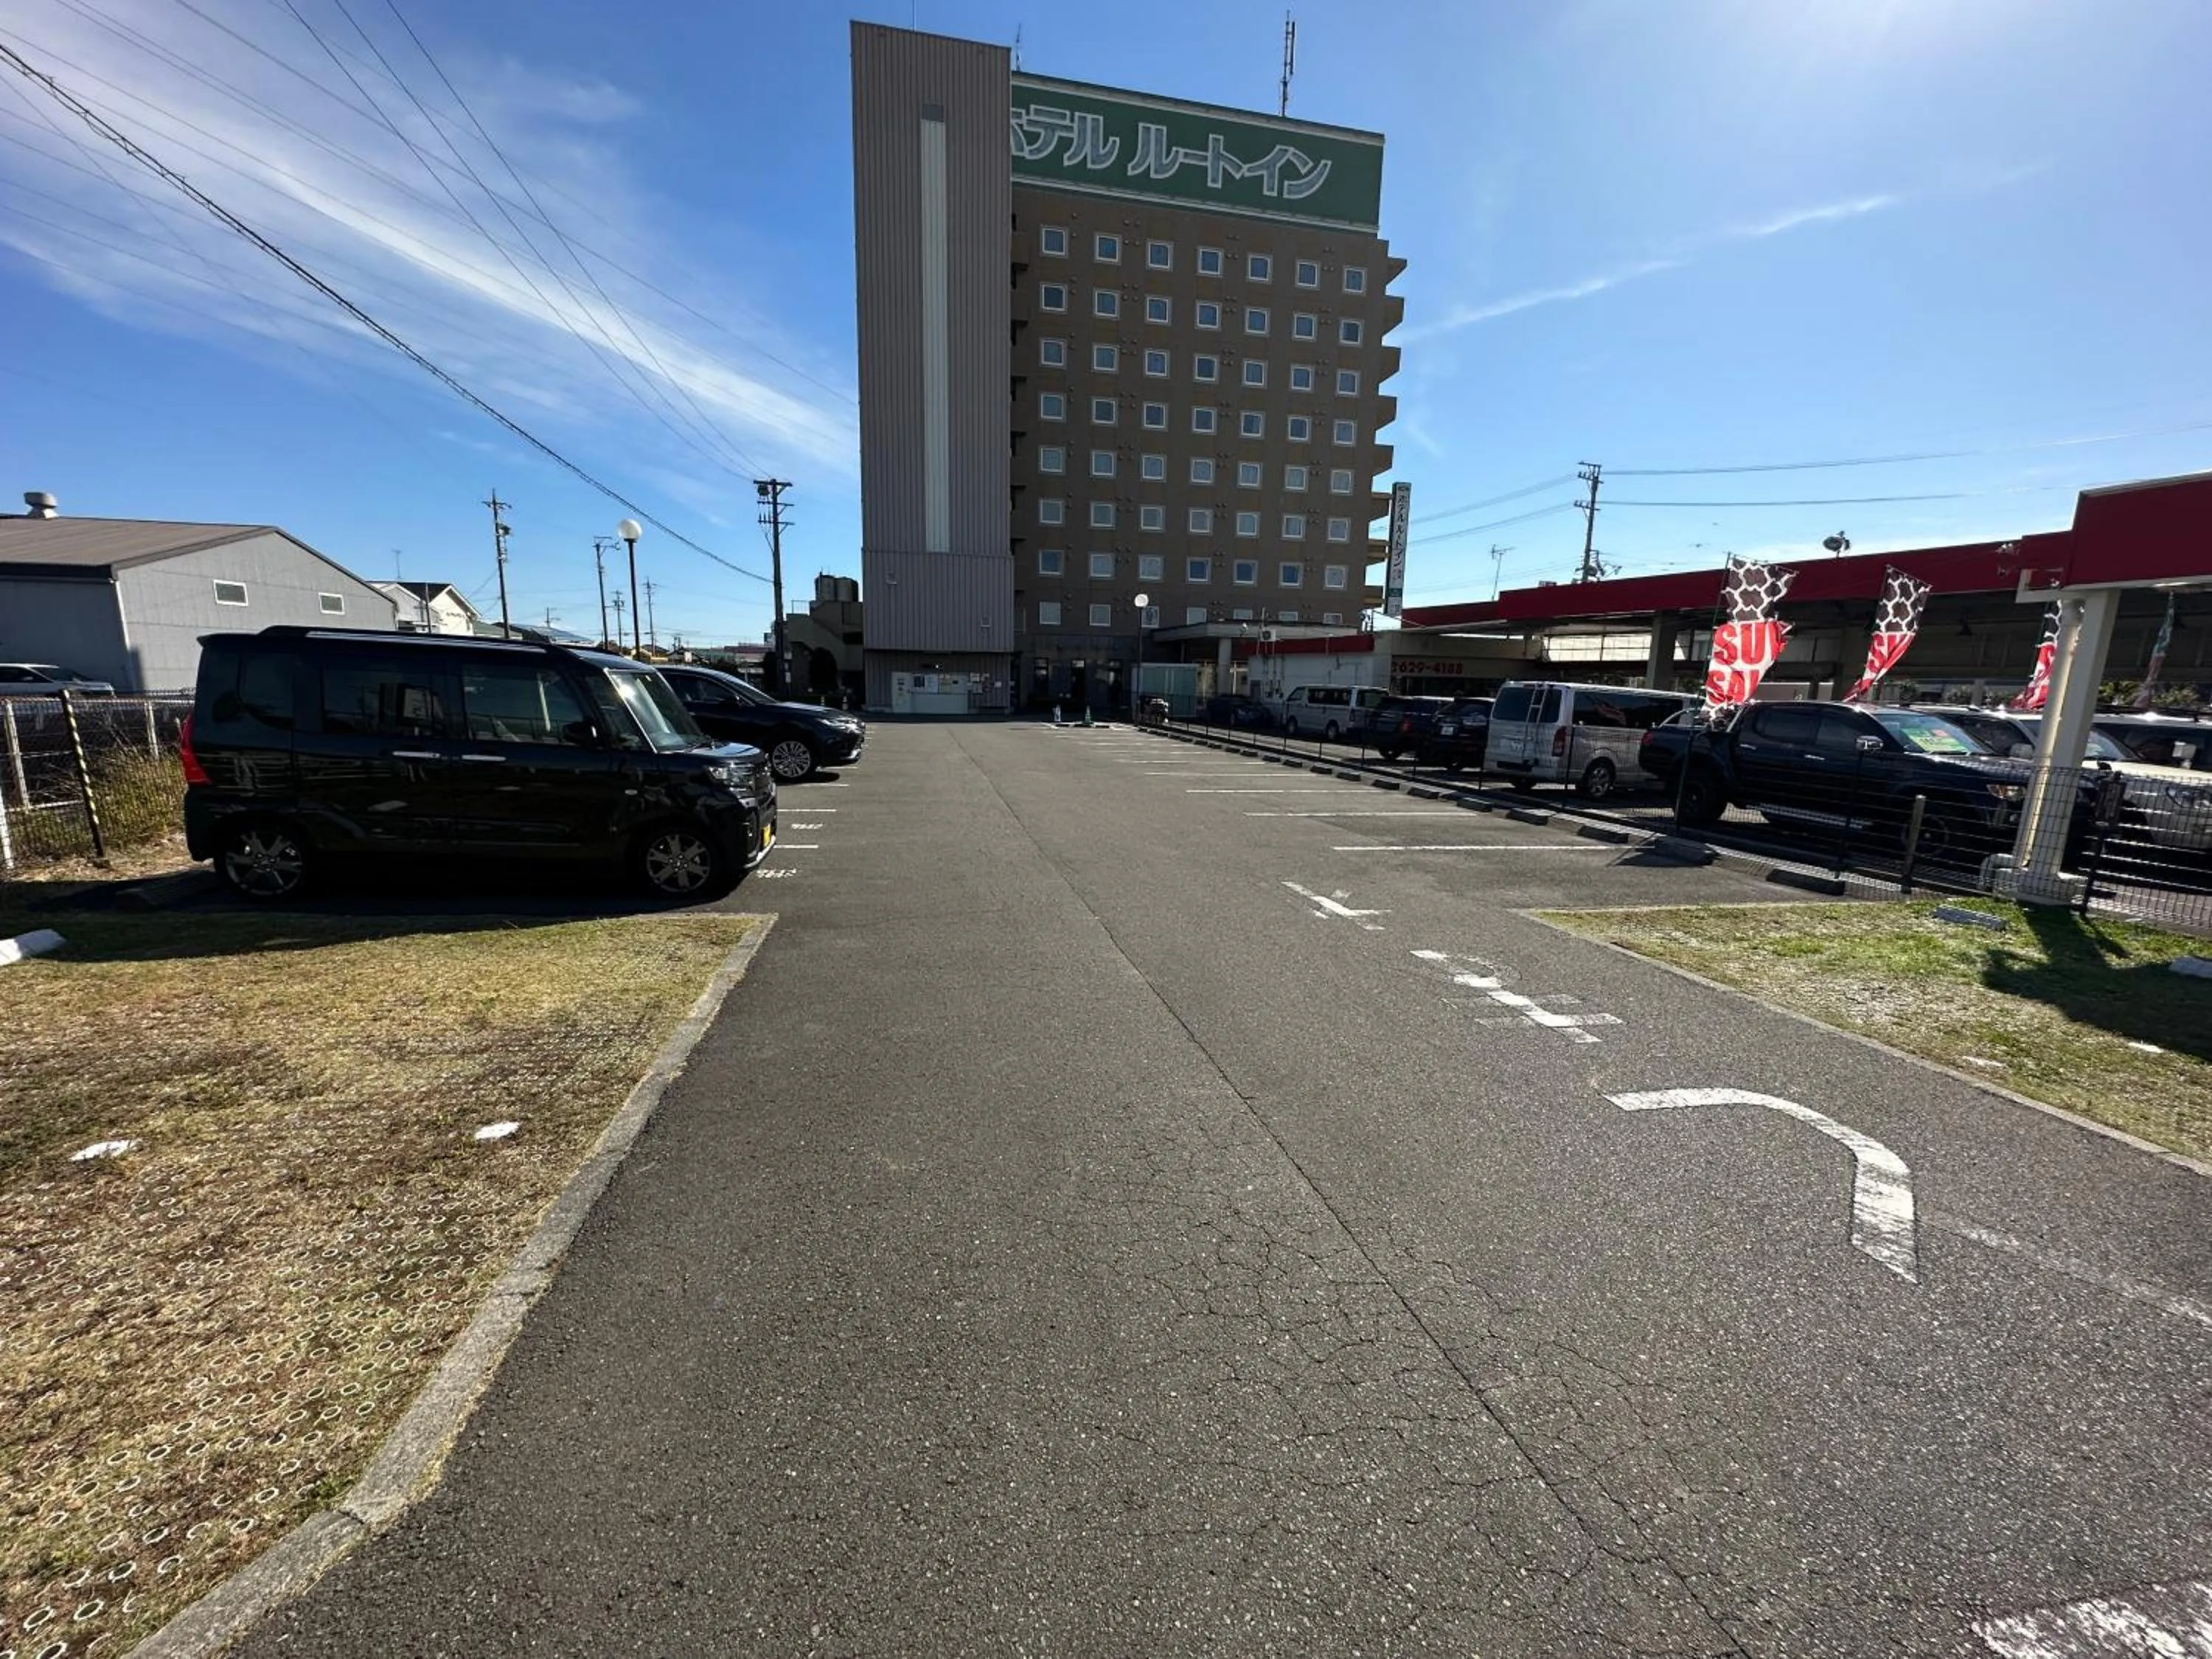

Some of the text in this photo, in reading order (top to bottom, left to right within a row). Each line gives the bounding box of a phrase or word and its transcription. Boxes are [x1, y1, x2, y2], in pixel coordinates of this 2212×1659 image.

[1127, 122, 1332, 199] ルートイン
